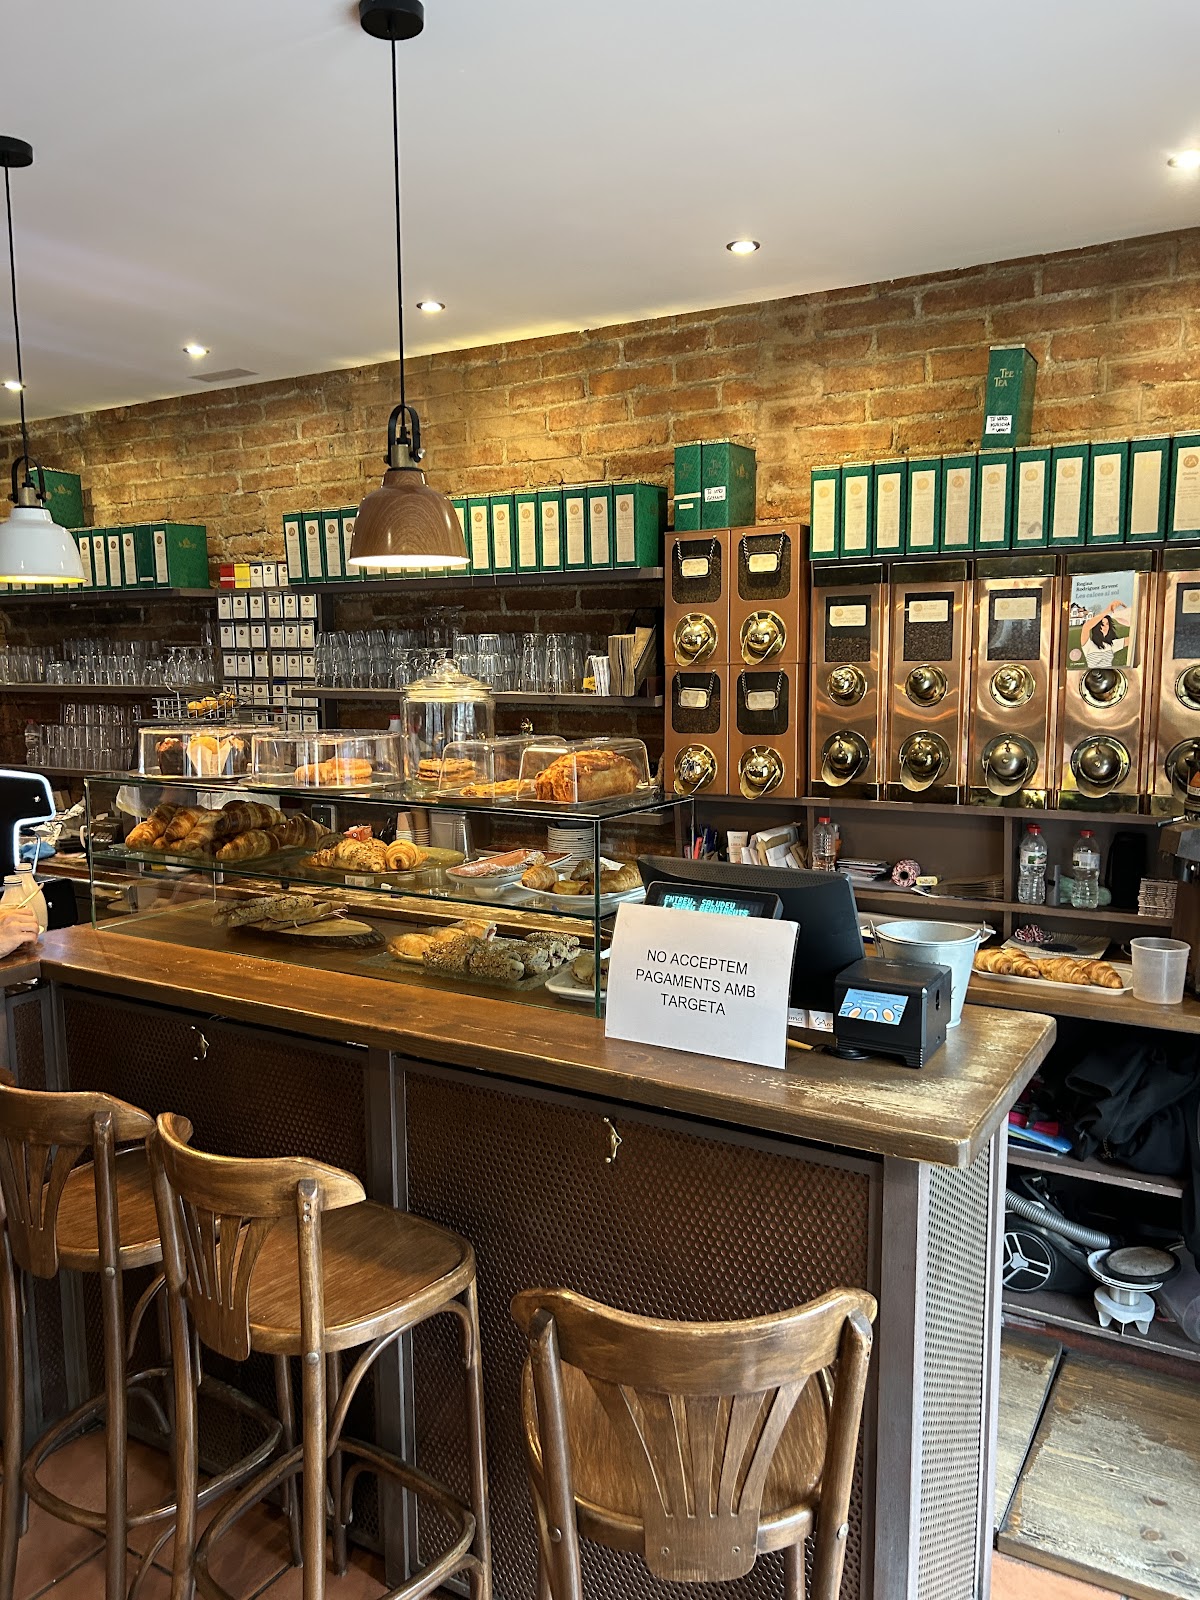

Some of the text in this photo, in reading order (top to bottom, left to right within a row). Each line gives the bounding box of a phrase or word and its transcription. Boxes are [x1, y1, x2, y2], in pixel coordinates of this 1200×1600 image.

[701, 898, 736, 909] SALUDEU
[647, 949, 748, 975] NO ACCEPTEM
[636, 968, 756, 998] PAGAMENTS AMB
[661, 993, 726, 1016] TARGETA
